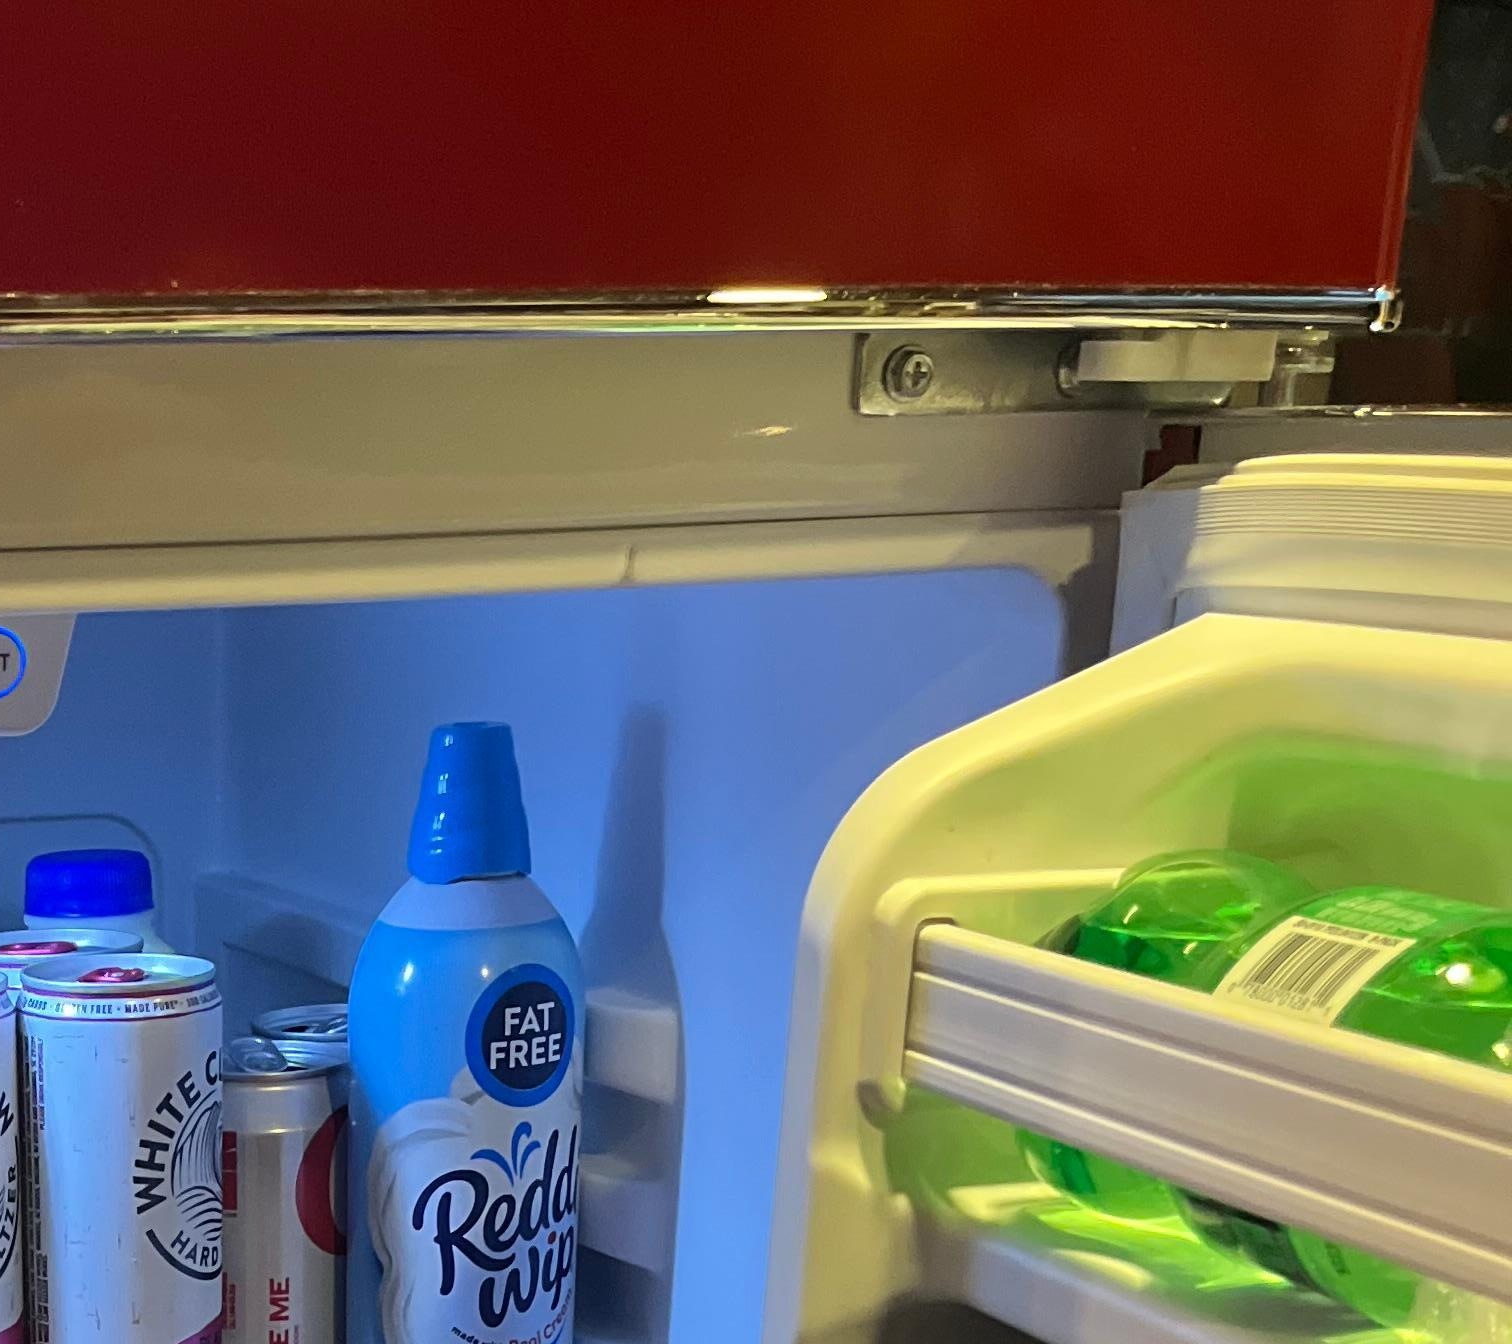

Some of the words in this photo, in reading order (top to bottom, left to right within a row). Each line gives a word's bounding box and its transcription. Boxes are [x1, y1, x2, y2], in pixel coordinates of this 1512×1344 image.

[504, 1001, 556, 1036] FAT
[489, 1032, 563, 1070] FREE
[131, 1069, 202, 1216] WHITE
[170, 1230, 220, 1267] HARD
[268, 1276, 290, 1322] ME
